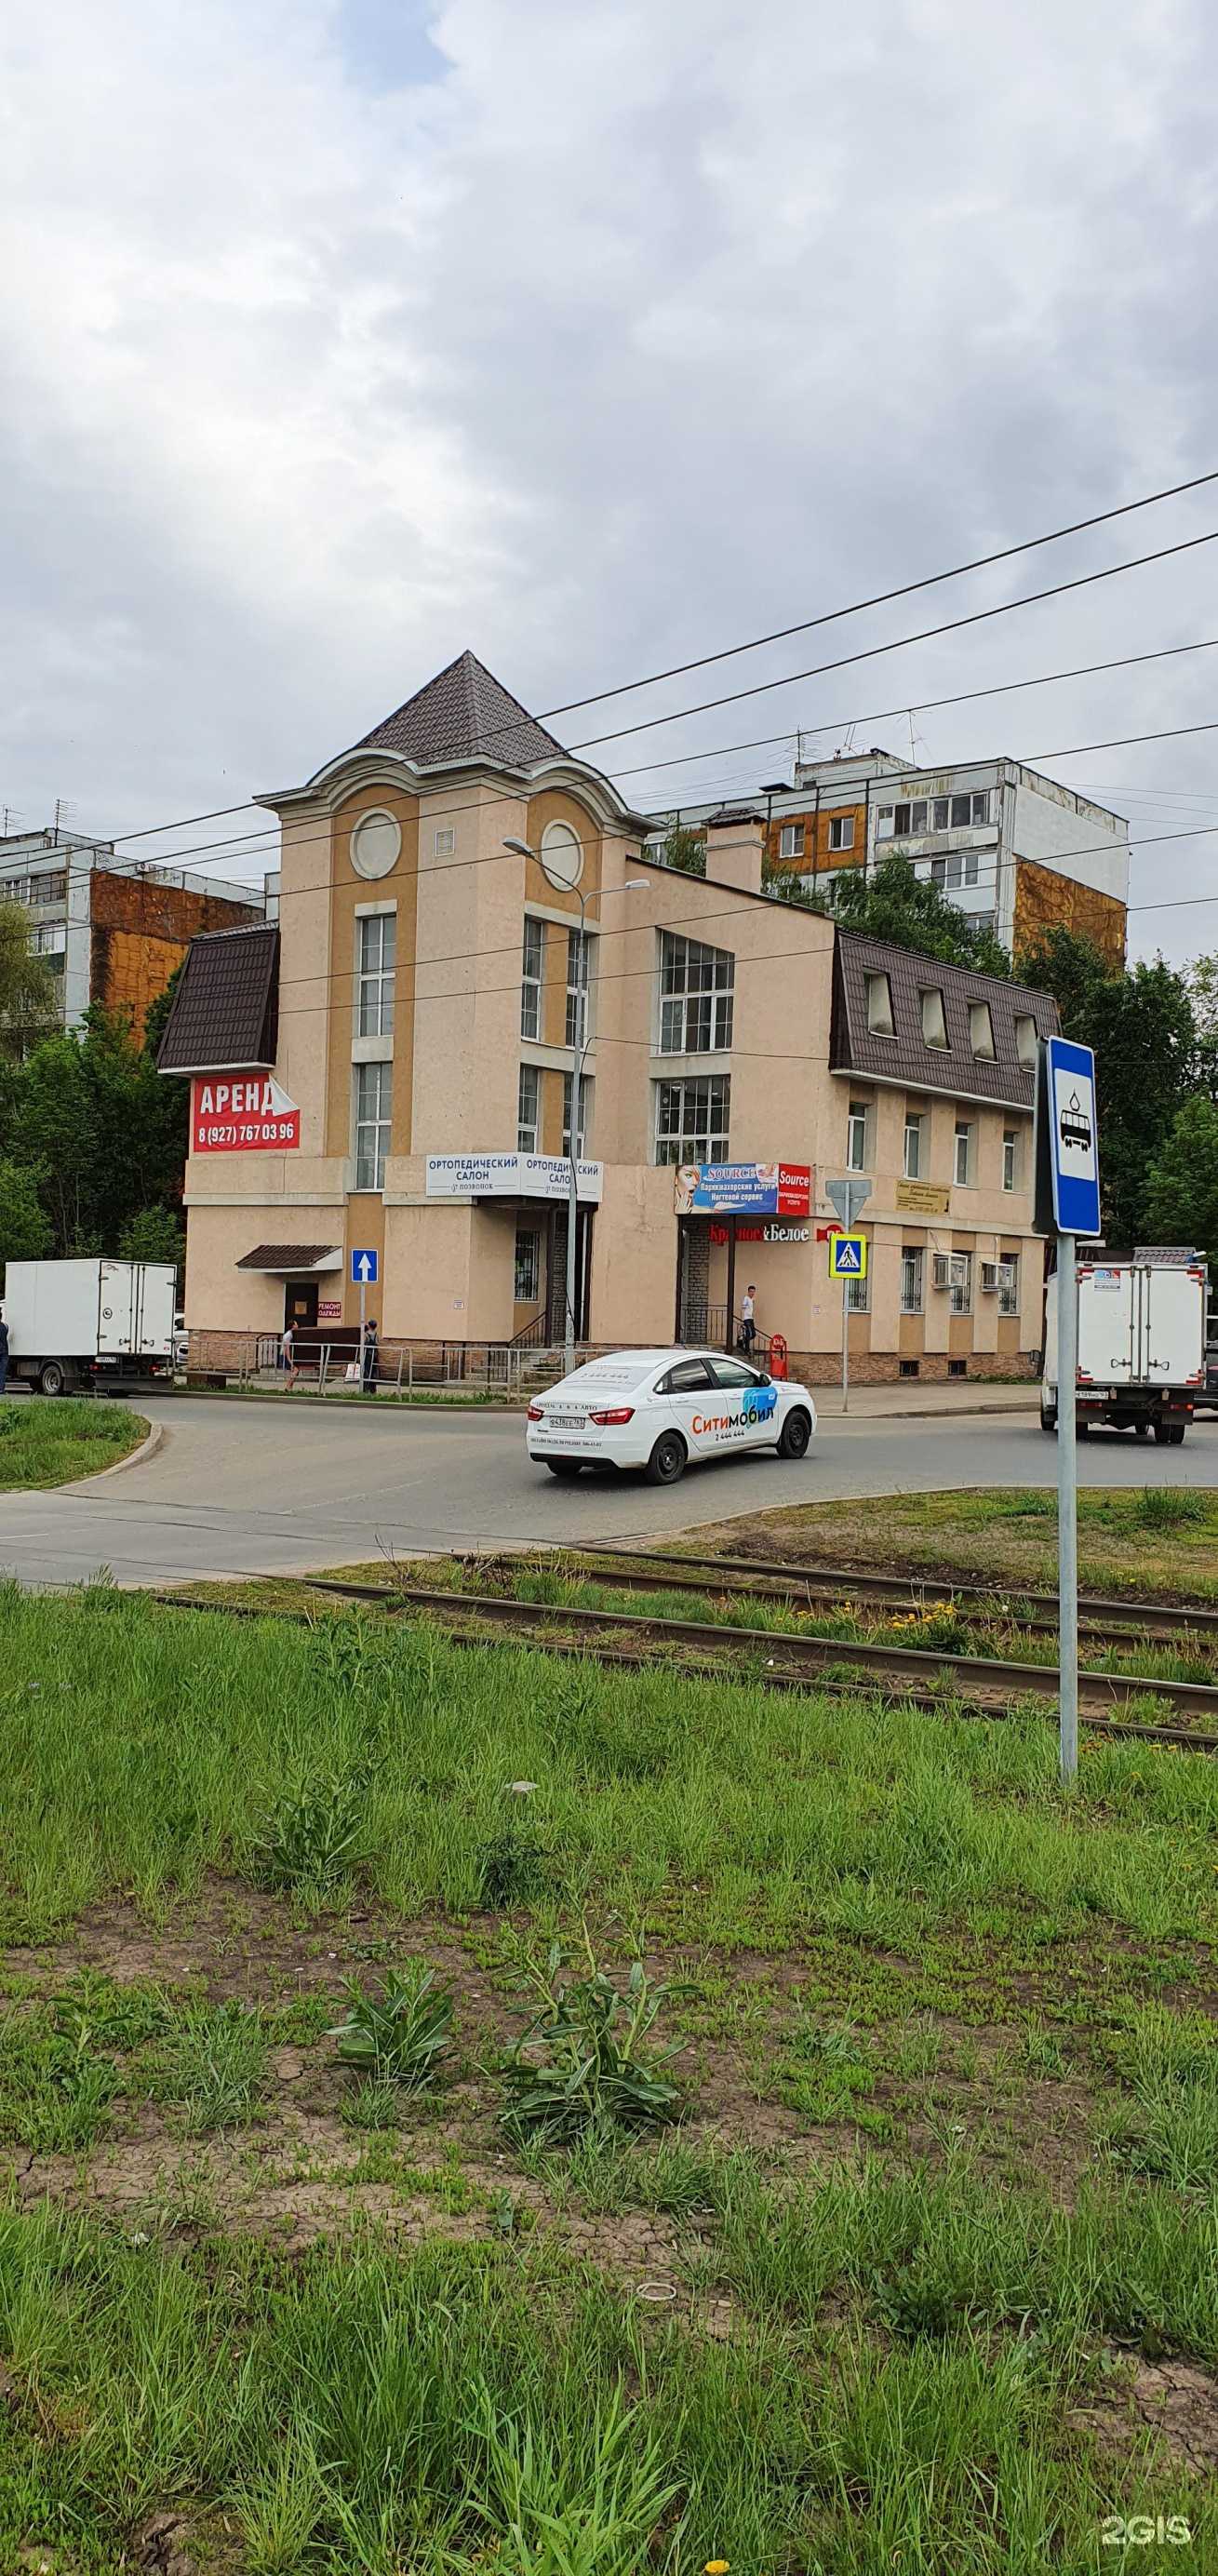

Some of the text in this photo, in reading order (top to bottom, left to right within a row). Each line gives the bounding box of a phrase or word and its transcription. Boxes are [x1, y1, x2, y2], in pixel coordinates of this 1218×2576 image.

[200, 1082, 276, 1117] АРЕНД
[198, 1122, 294, 1146] 8 (927) 767 03 96
[429, 1156, 518, 1170] ОРТОПЕДИЧЕСКИЙ
[526, 1160, 598, 1177] ОРТОПЕДИСКИЙ
[456, 1171, 489, 1181] САЛОН
[549, 1173, 571, 1185] САЛО
[707, 1167, 757, 1179] SOURCE
[779, 1171, 810, 1187] Source
[692, 1404, 774, 1434] Ситимобил
